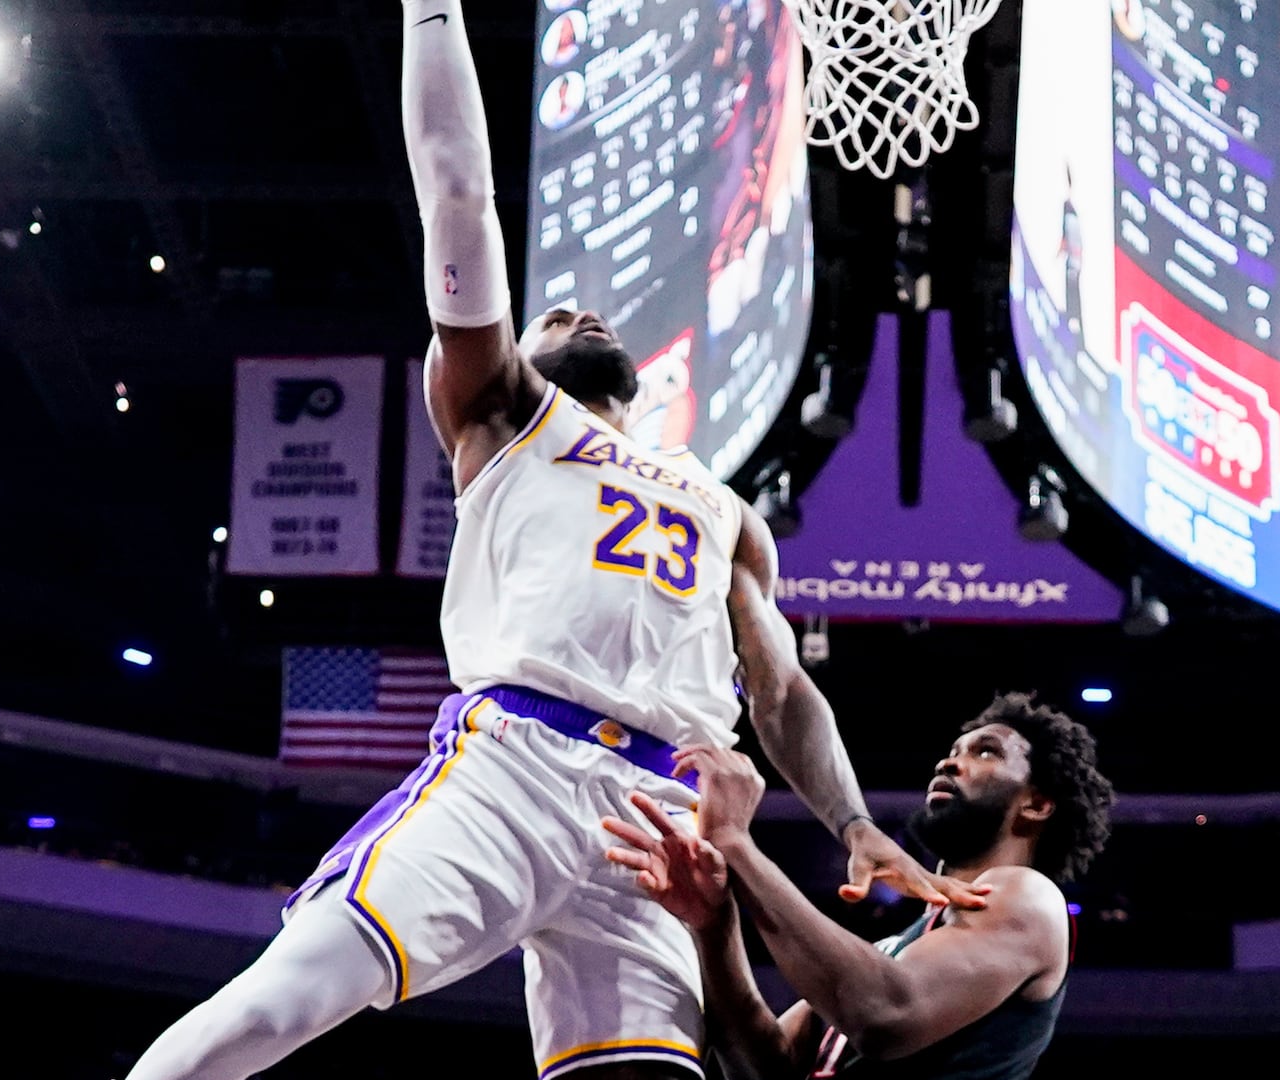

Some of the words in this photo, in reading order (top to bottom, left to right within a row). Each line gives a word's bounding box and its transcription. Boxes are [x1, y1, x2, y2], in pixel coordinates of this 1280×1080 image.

[553, 425, 722, 518] LAKERS
[592, 482, 701, 598] 23
[776, 576, 905, 602] mobil
[915, 577, 1069, 607] xfinity
